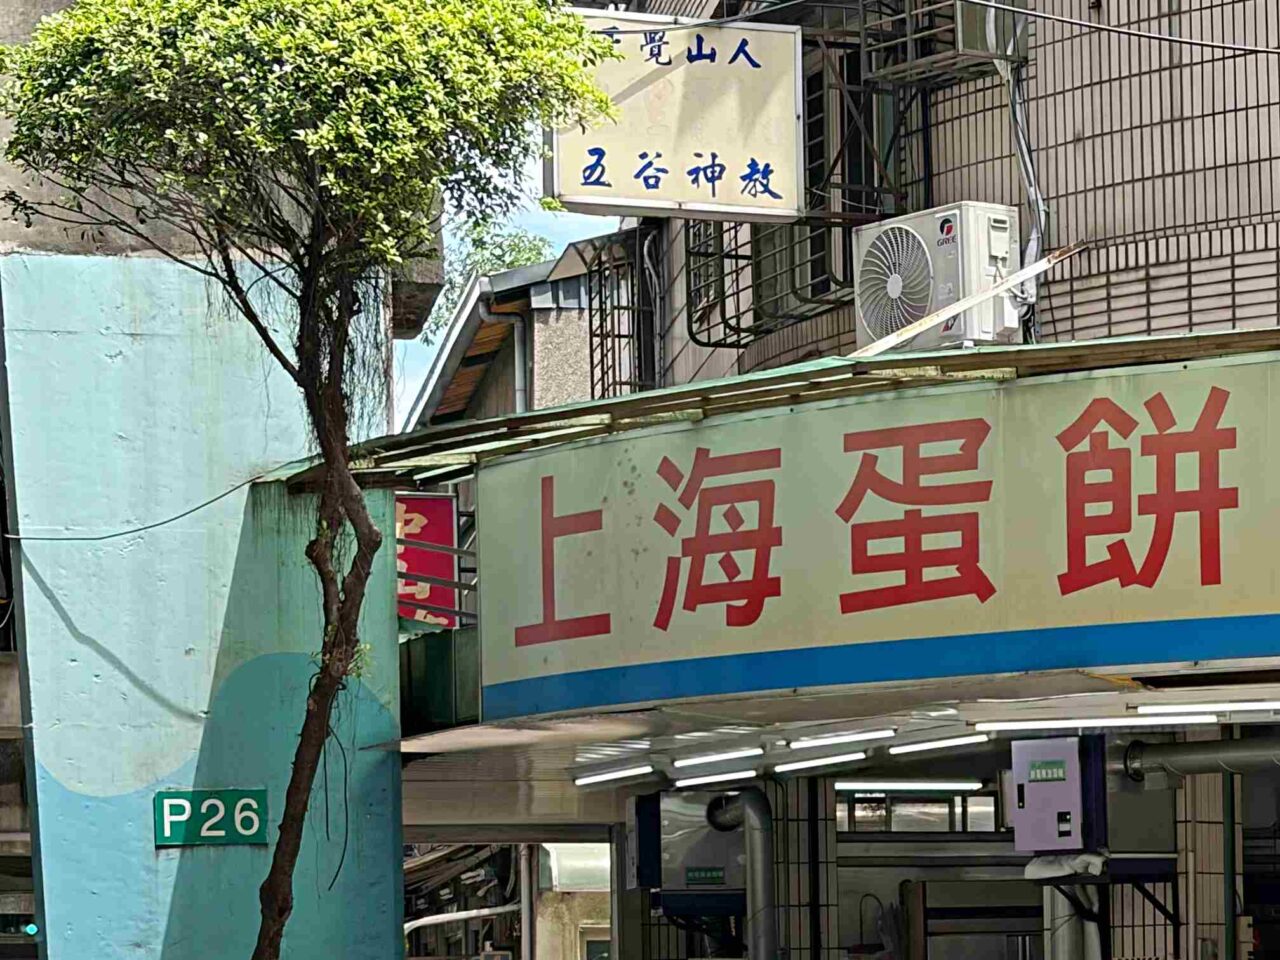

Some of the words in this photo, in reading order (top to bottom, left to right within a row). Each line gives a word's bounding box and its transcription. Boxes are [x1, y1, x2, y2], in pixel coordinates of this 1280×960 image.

[602, 26, 761, 68] 覺山人
[581, 147, 783, 200] 五谷神教
